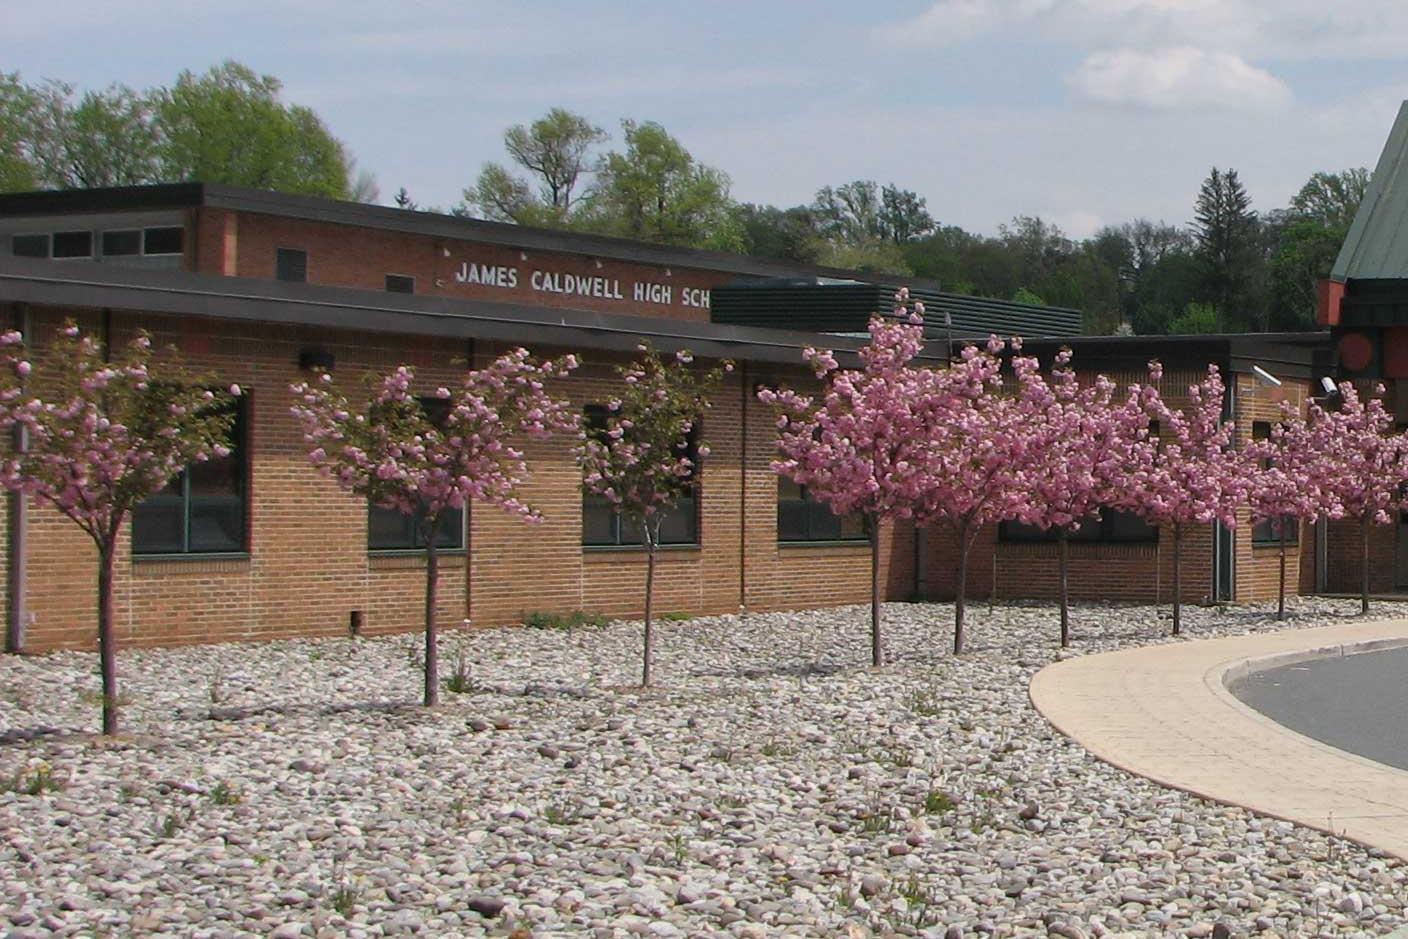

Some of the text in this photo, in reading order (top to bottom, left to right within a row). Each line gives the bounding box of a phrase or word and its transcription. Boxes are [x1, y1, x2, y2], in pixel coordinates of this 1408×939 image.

[455, 262, 711, 309] JAMES CALDWELL HIGH SCH
